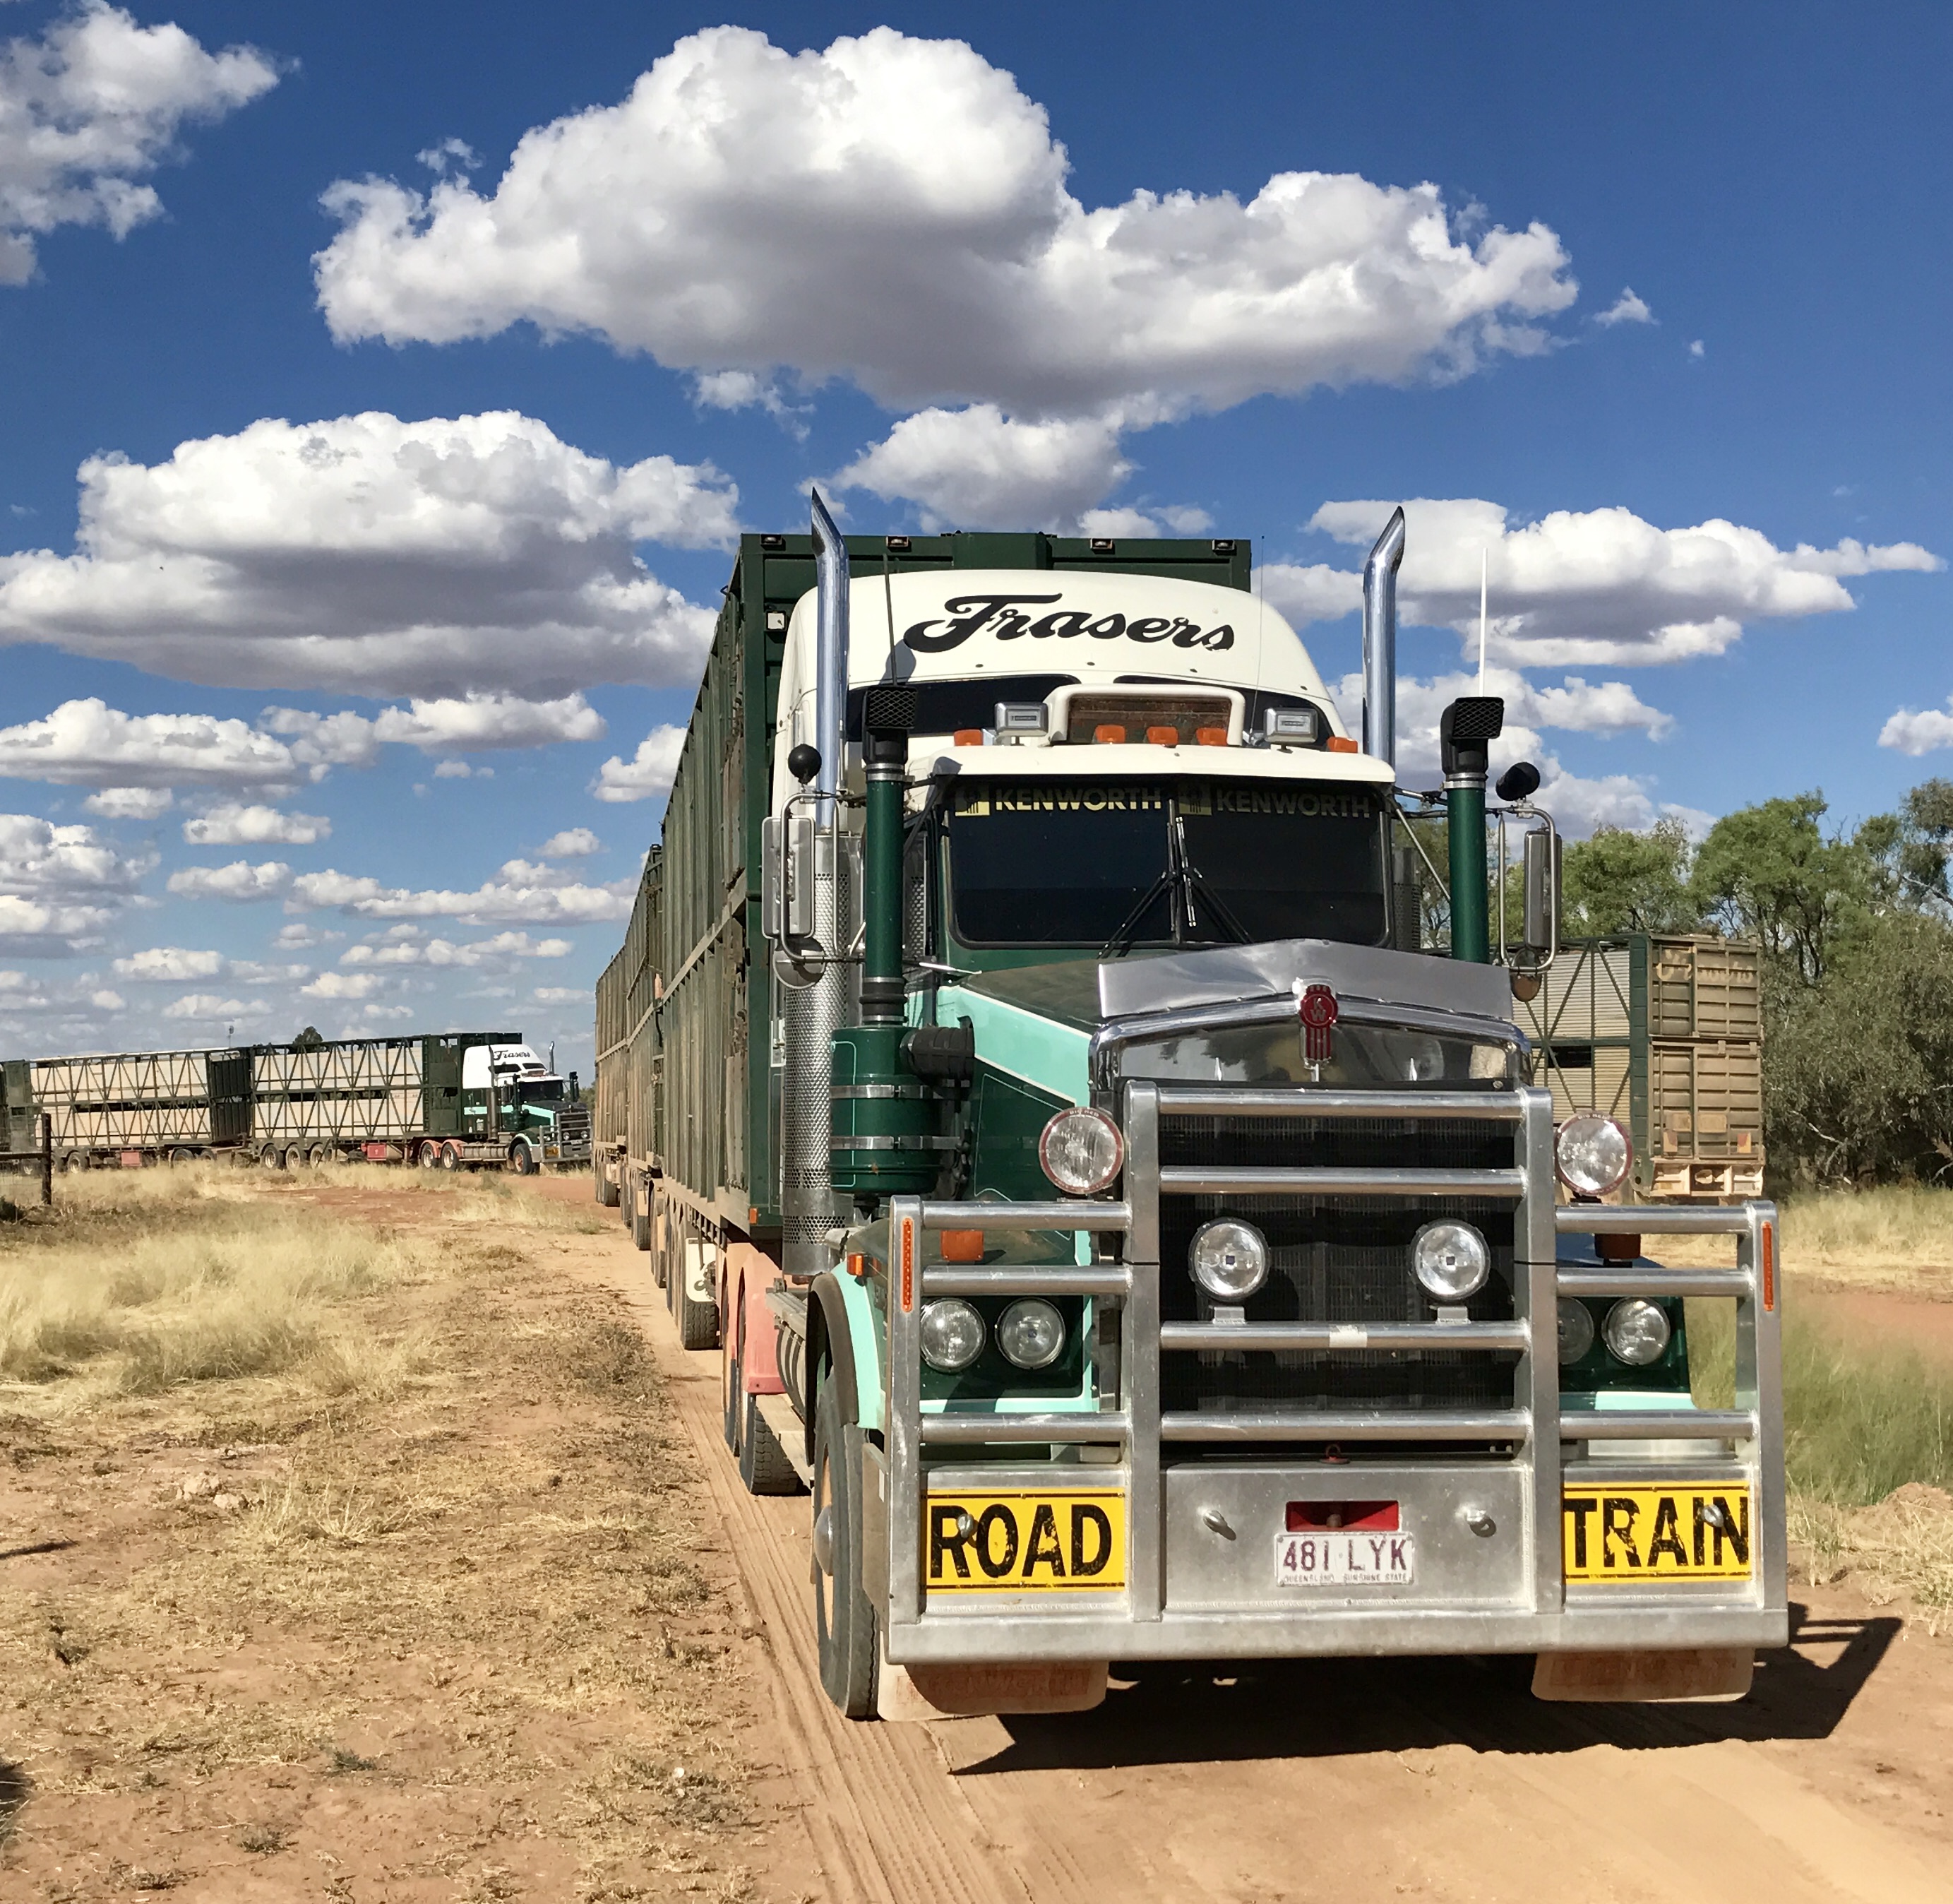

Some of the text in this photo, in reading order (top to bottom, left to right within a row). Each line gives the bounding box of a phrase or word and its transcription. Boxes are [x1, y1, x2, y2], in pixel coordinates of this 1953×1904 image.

[903, 593, 1234, 653] Frasers
[996, 788, 1161, 811] KENWORTH
[1217, 790, 1370, 818] KENWORTH
[930, 1504, 1112, 1578] ROAD
[1284, 1539, 1406, 1571] 481 LYK
[1563, 1497, 1749, 1568] TRAIN
